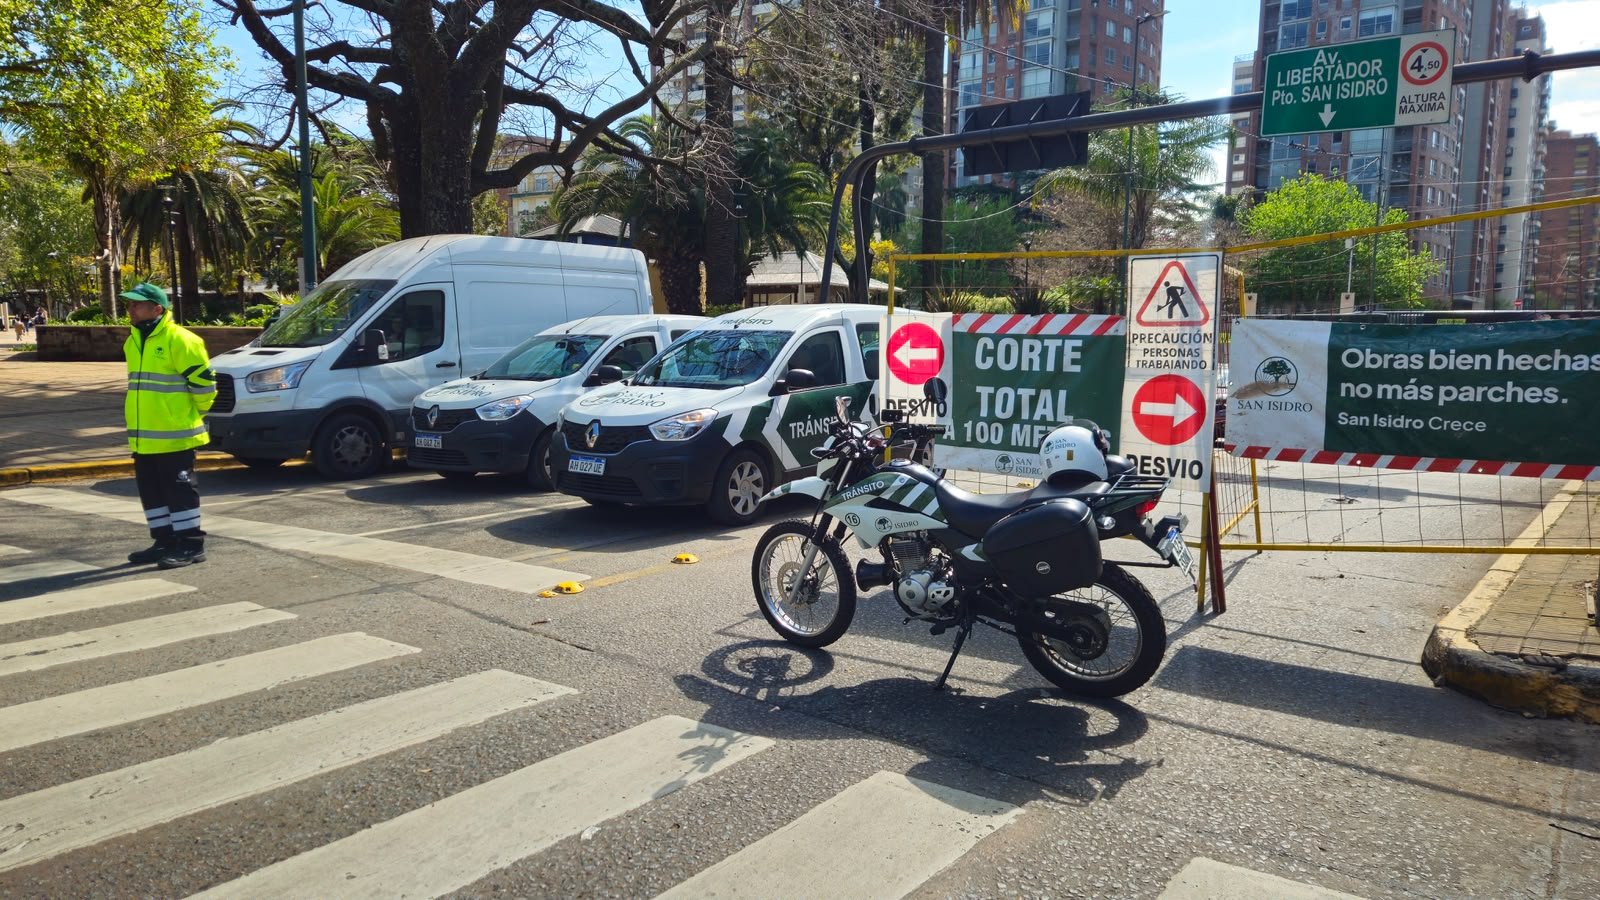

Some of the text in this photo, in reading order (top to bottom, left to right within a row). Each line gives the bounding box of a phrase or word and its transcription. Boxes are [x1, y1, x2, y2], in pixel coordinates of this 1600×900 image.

[1313, 49, 1342, 66] Av.
[1276, 58, 1383, 88] LIBERTADOR
[1271, 77, 1389, 107] Pto. SAN ISIDRO
[1399, 91, 1447, 105] ALTURA
[1131, 330, 1213, 344] PRECAUCIÓN
[974, 336, 1084, 373] CORTE
[1143, 347, 1201, 358] PERSONAS
[1341, 347, 1600, 373] Obras bien hechas
[1340, 377, 1568, 406] no más parches.
[975, 385, 1074, 424] TOTAL
[1237, 399, 1314, 414] SAN ISIDRO
[789, 414, 838, 440] TRÁNS
[942, 418, 956, 441] A
[963, 420, 1004, 446] 100
[1337, 411, 1487, 432] San Isidro Crece
[569, 460, 579, 470] AH
[579, 462, 593, 474] 027
[1016, 457, 1032, 466] SAN
[841, 480, 885, 501] TRÁNSITO
[847, 515, 858, 524] 16
[895, 520, 919, 529] ISIDRO
